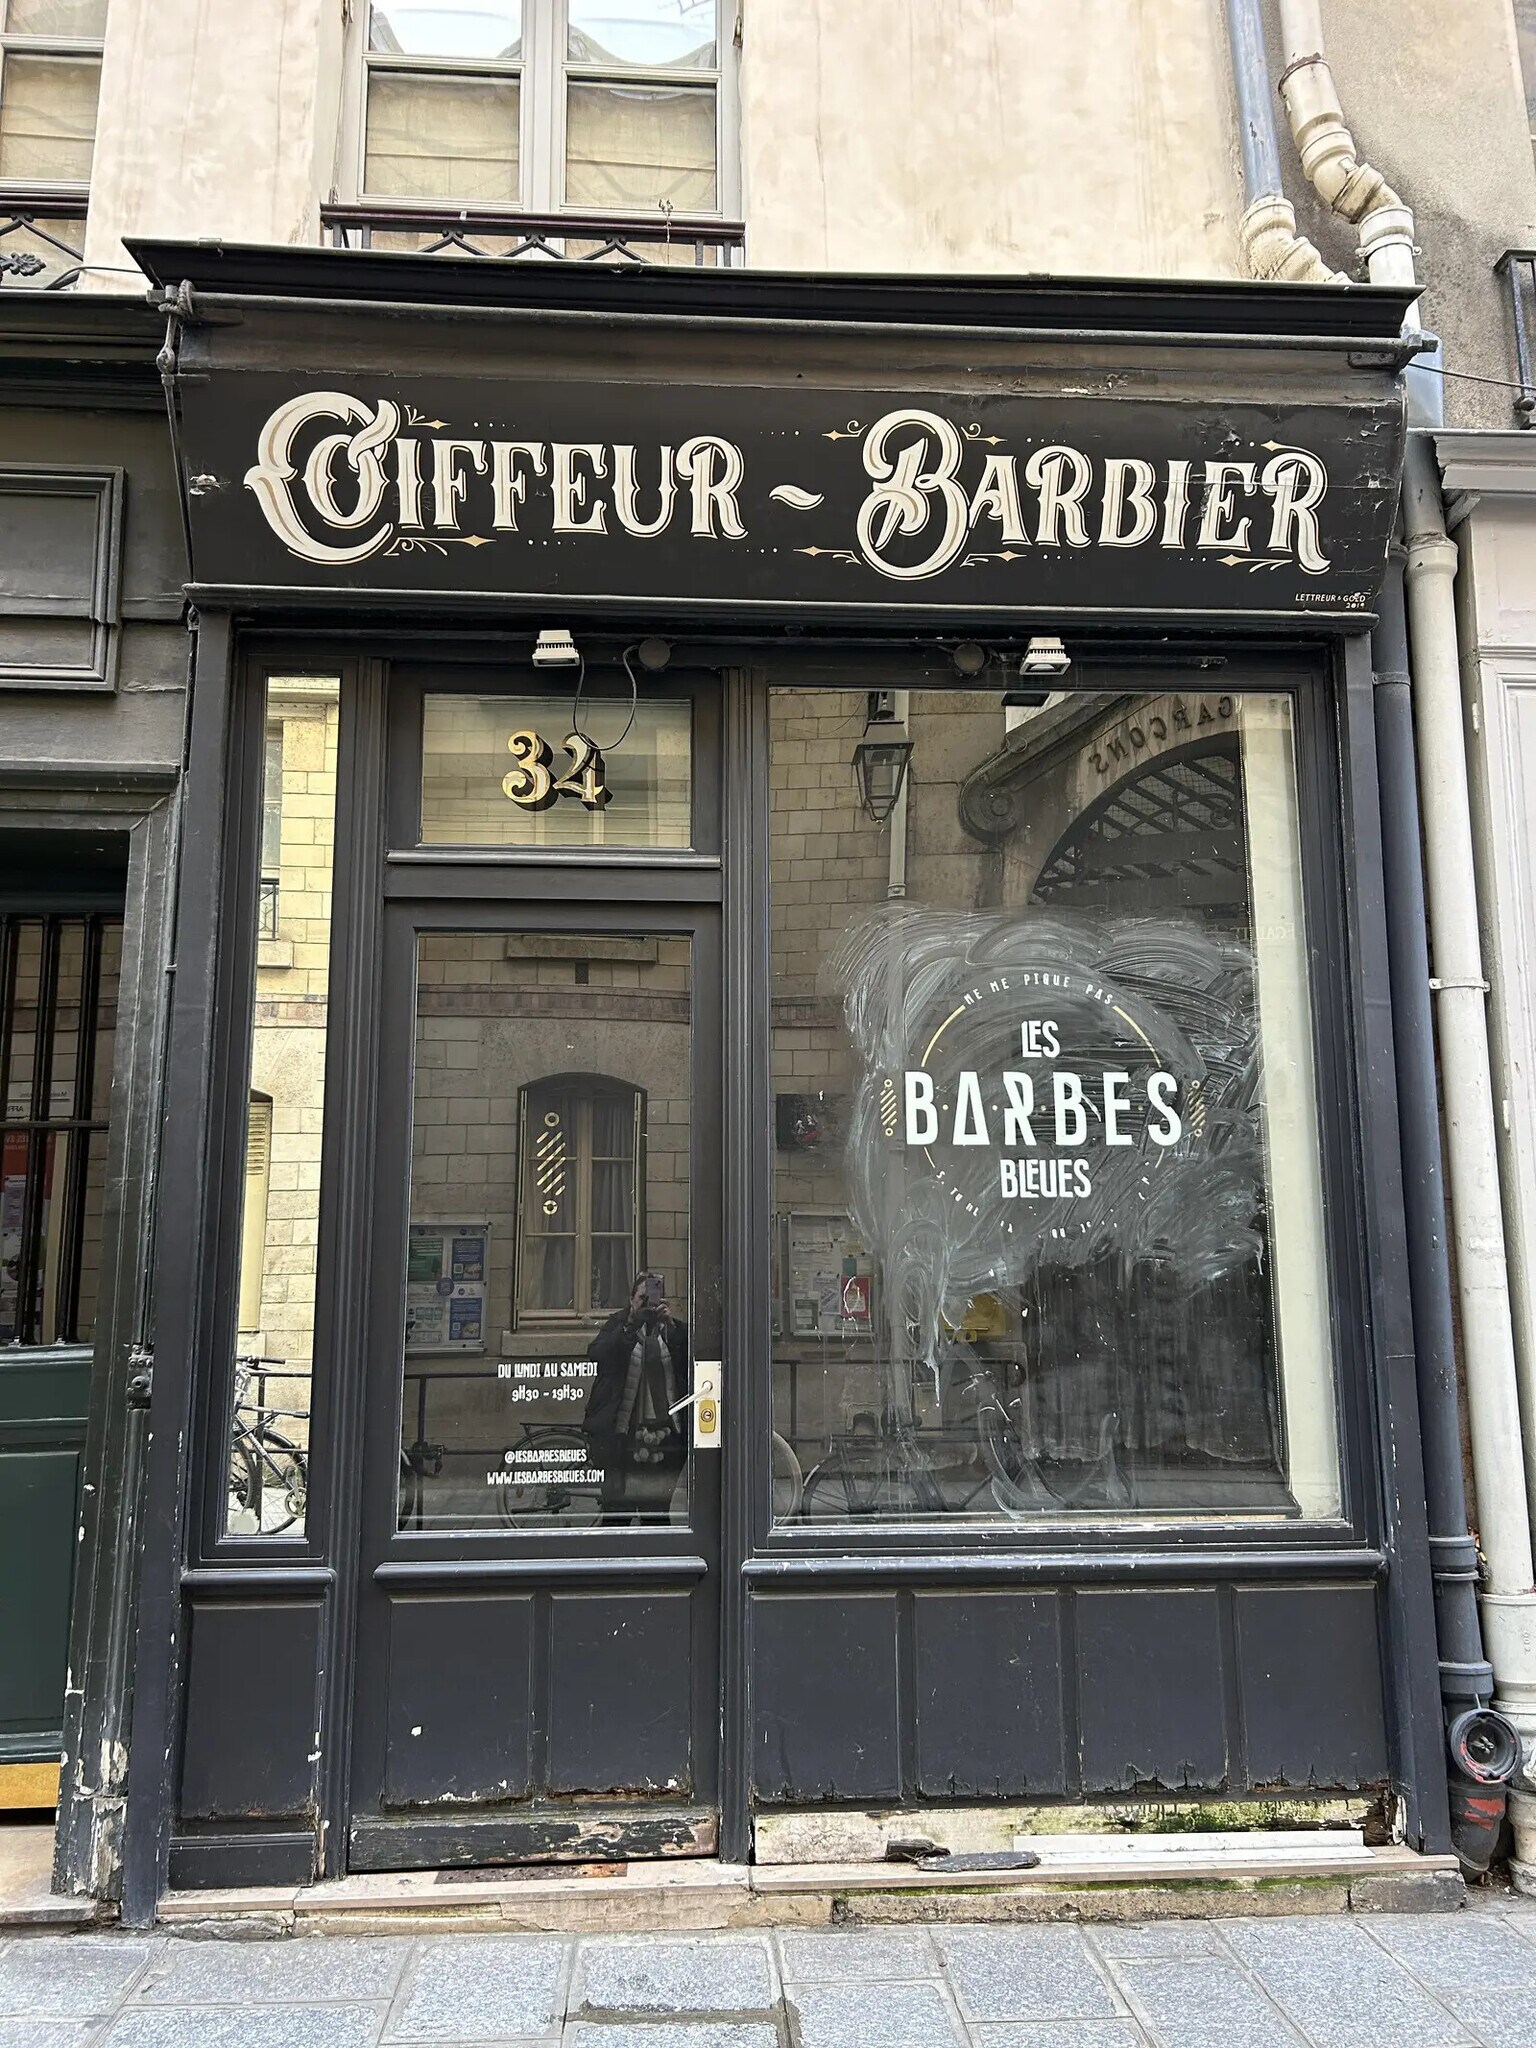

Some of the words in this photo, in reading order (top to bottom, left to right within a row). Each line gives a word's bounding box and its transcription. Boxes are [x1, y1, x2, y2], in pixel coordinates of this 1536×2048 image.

[244, 391, 749, 565] COIFFEUR
[856, 409, 1330, 581] BARBIER
[1295, 593, 1336, 602] LETTREUR
[502, 731, 613, 811] 34
[964, 988, 983, 1005] NE
[990, 977, 1010, 993] ME
[1023, 973, 1071, 988] PIQUE
[1085, 984, 1113, 1005] PAS
[1021, 1020, 1059, 1058] LES
[904, 1071, 1182, 1146] BARBES
[1000, 1158, 1092, 1199] BLEUES
[497, 1364, 512, 1378] DU
[514, 1363, 541, 1378] LUNDI
[544, 1363, 558, 1377] AU
[560, 1361, 598, 1376] SAMEDI
[512, 1385, 540, 1401] 9H30
[552, 1384, 584, 1400] 19H30
[504, 1448, 587, 1464] @LESBARBESBLEUES
[487, 1469, 605, 1485] WWW.LESBARBESBLEUES.COM
